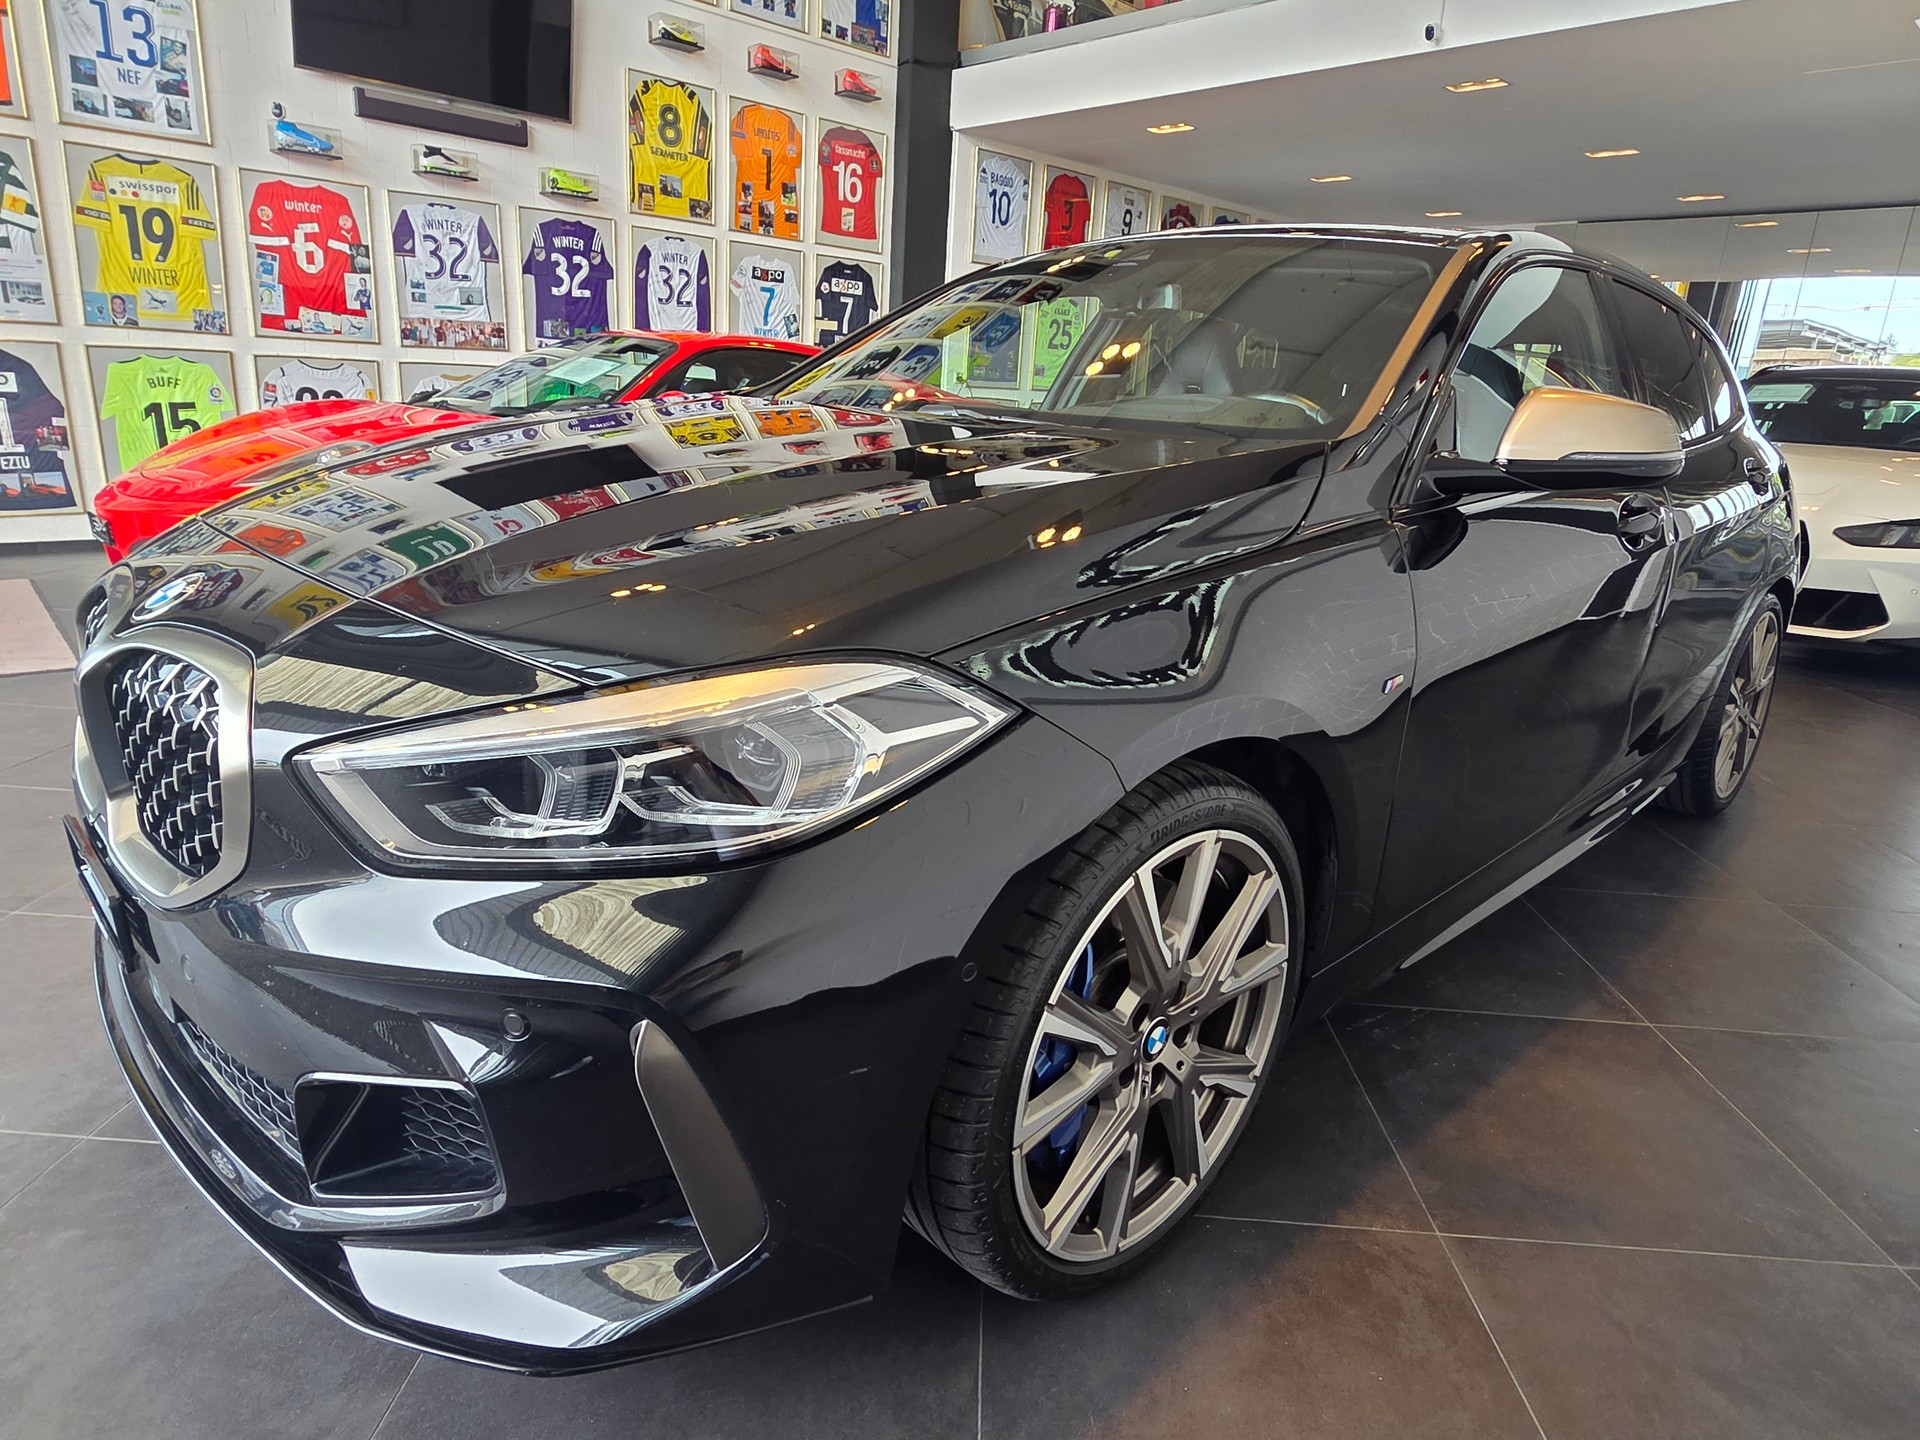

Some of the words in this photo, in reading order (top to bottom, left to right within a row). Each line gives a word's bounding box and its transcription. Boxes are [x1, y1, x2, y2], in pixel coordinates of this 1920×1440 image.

[89, 0, 158, 68] 13
[116, 67, 142, 85] NEF
[658, 103, 683, 148] 8
[760, 147, 773, 191] 1
[832, 160, 863, 204] 16
[284, 200, 323, 214] winter
[424, 218, 463, 234] WINTER
[988, 188, 1012, 226] 10
[1061, 199, 1075, 231] 3
[1121, 208, 1133, 236] 9
[118, 204, 175, 263] 19
[291, 222, 325, 275] 6
[552, 235, 584, 251] WINTER
[127, 266, 180, 287] WINTER
[422, 234, 472, 281] 32
[550, 252, 592, 298] 32
[661, 252, 689, 266] WINTER
[657, 265, 693, 307] 32
[760, 286, 775, 326] 7
[840, 296, 854, 334] 7
[1047, 318, 1073, 350] 25
[146, 376, 182, 390] BUFF
[141, 402, 202, 450] 15
[1150, 803, 1228, 847] BRIDGESTONE
